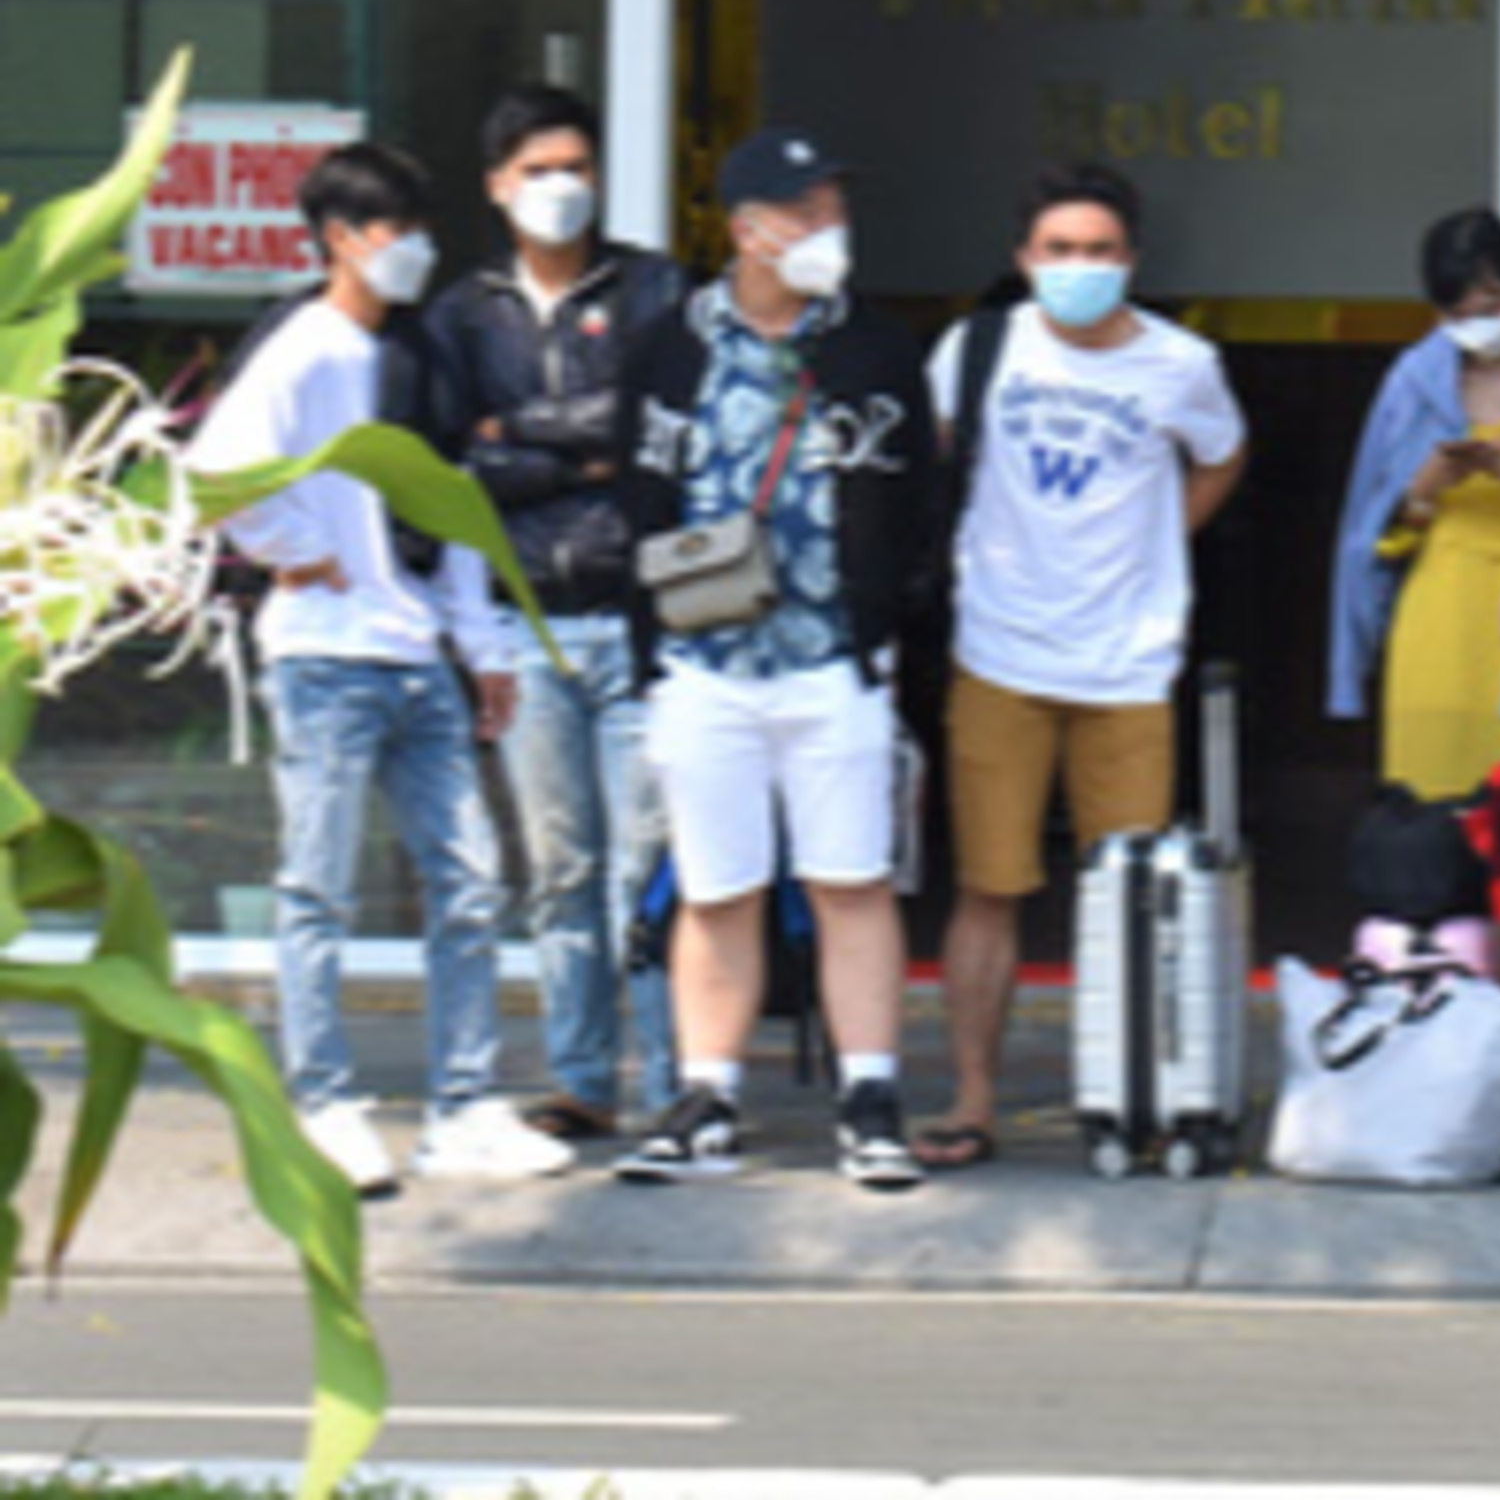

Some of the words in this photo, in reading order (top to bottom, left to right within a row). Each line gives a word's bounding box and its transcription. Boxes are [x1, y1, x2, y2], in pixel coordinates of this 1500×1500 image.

[1036, 82, 1286, 160] Hotel
[148, 224, 331, 271] VACANC
[1029, 445, 1101, 498] W
